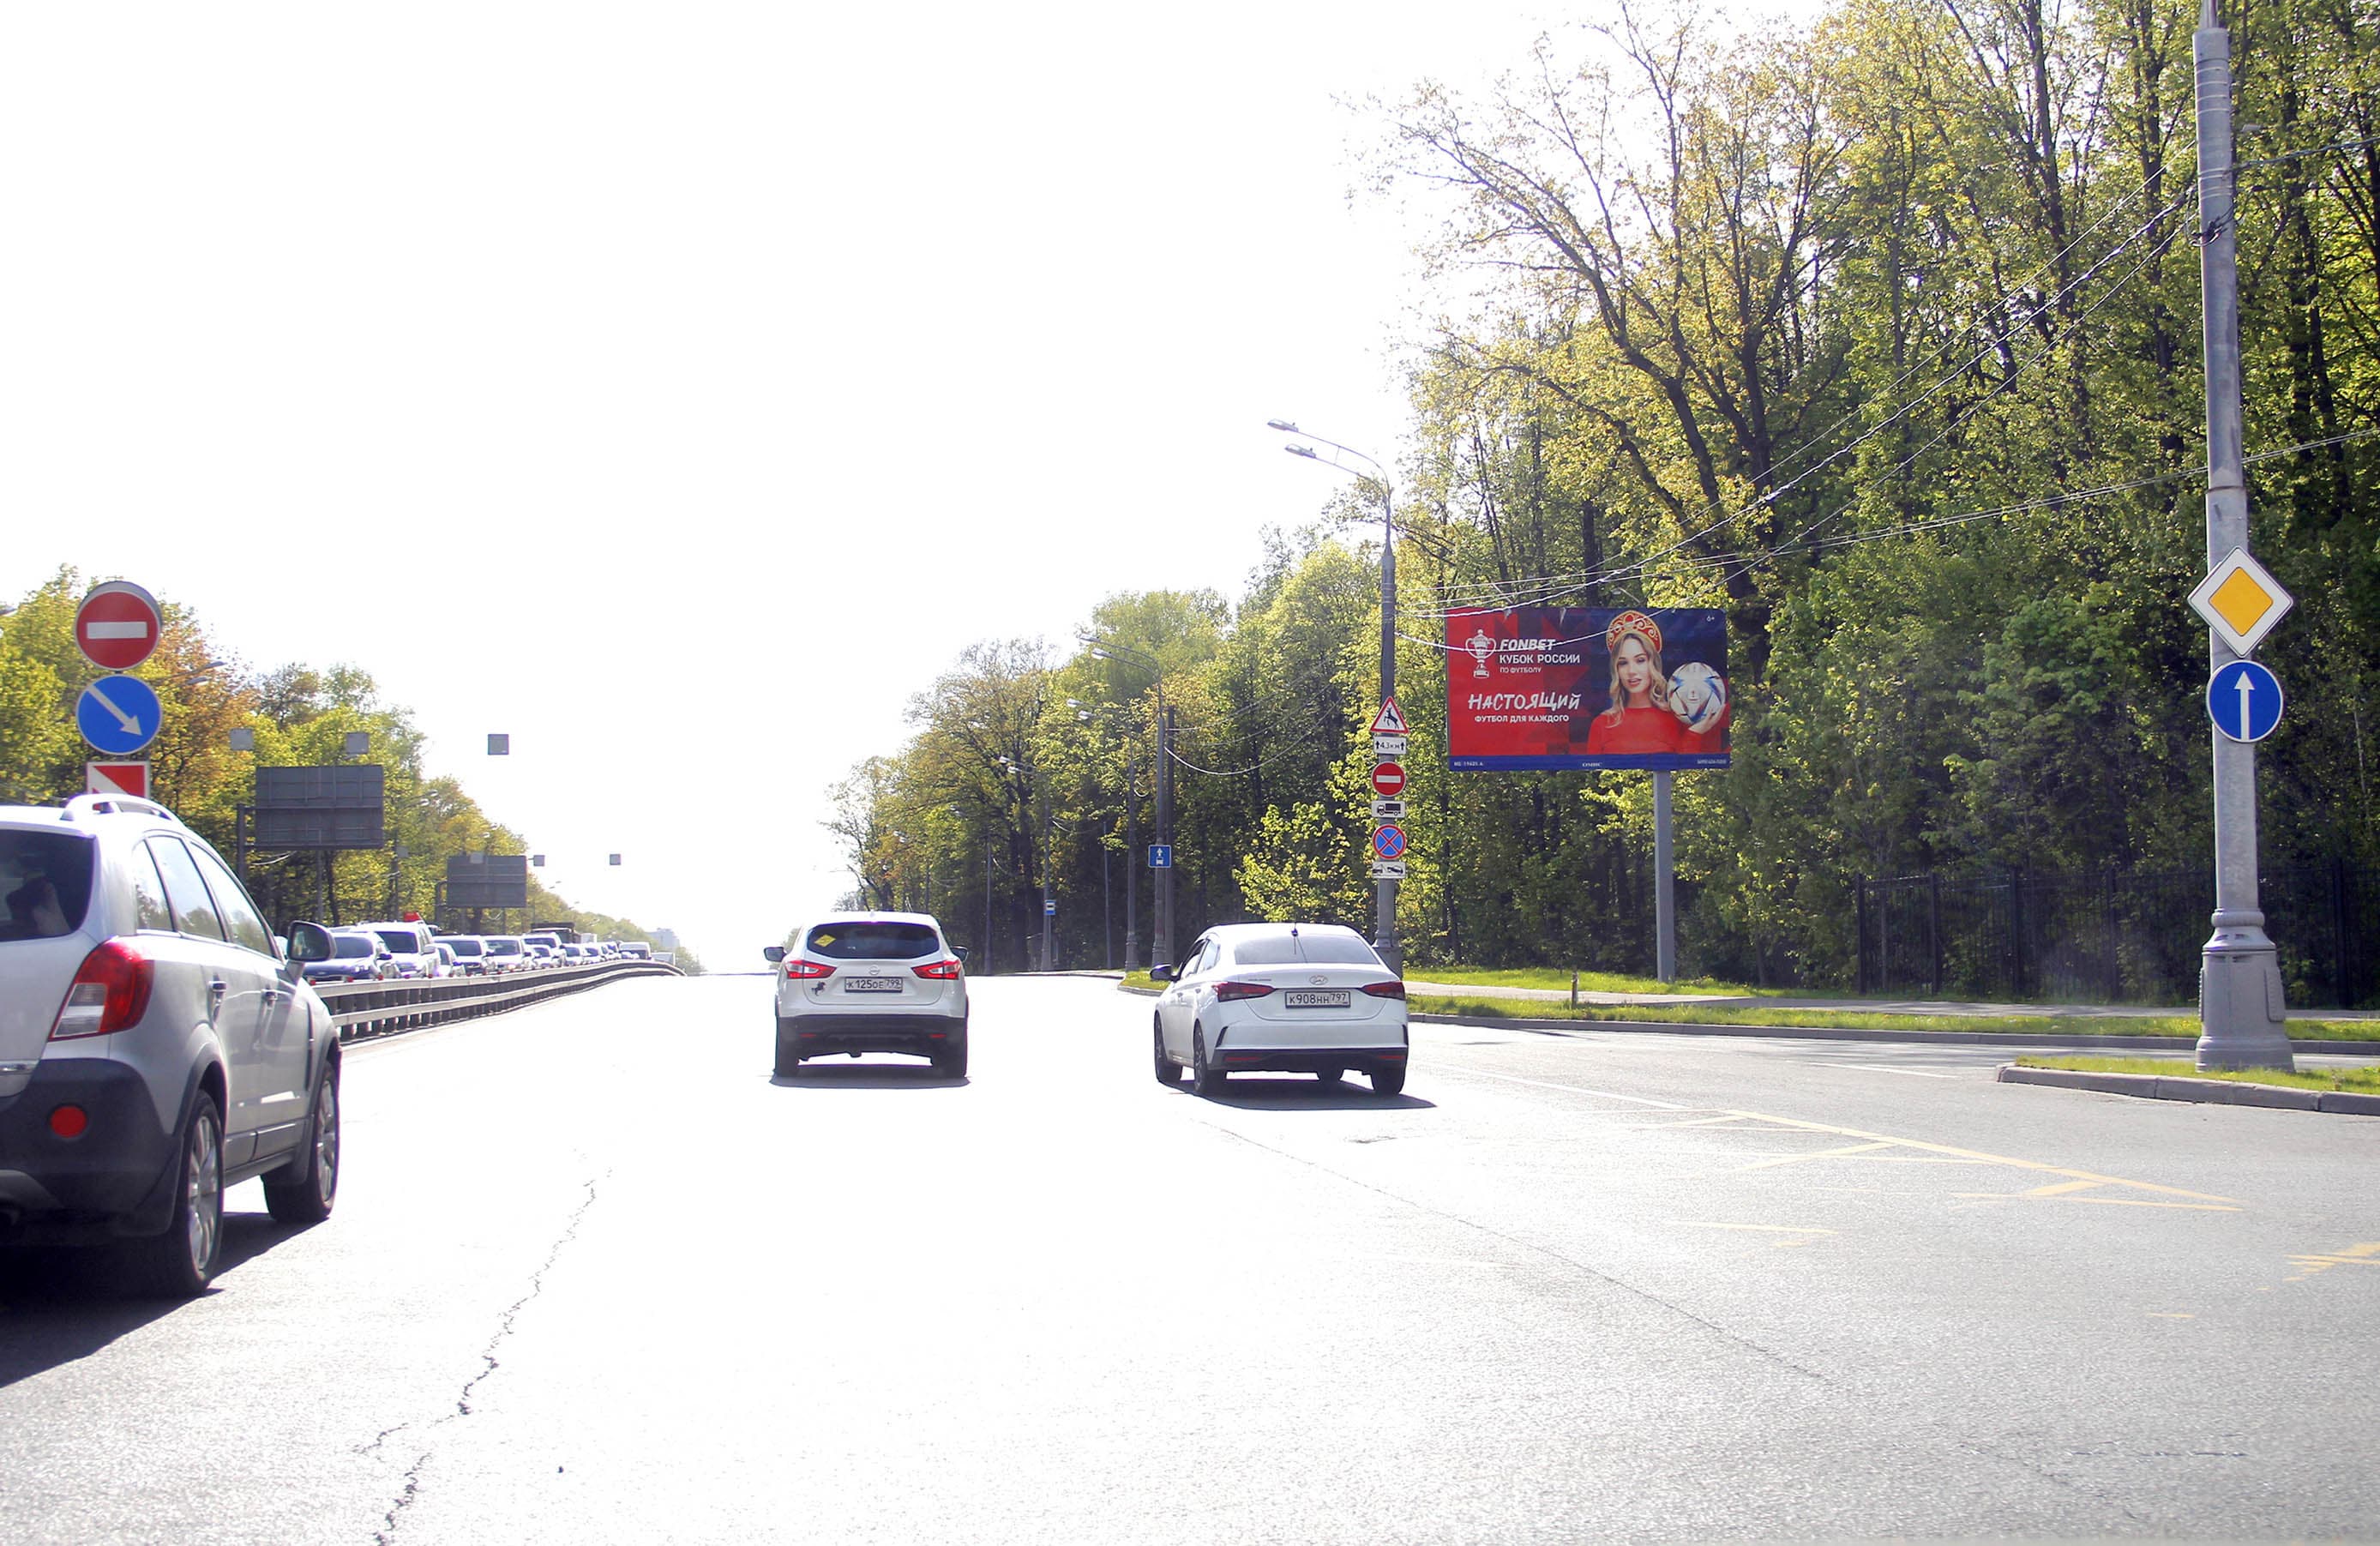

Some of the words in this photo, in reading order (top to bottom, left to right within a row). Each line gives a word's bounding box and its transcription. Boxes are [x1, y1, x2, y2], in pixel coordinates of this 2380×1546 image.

[1500, 639, 1556, 651] FONBET
[1500, 654, 1534, 664] КУБОК
[1537, 654, 1580, 664] РОССИИ
